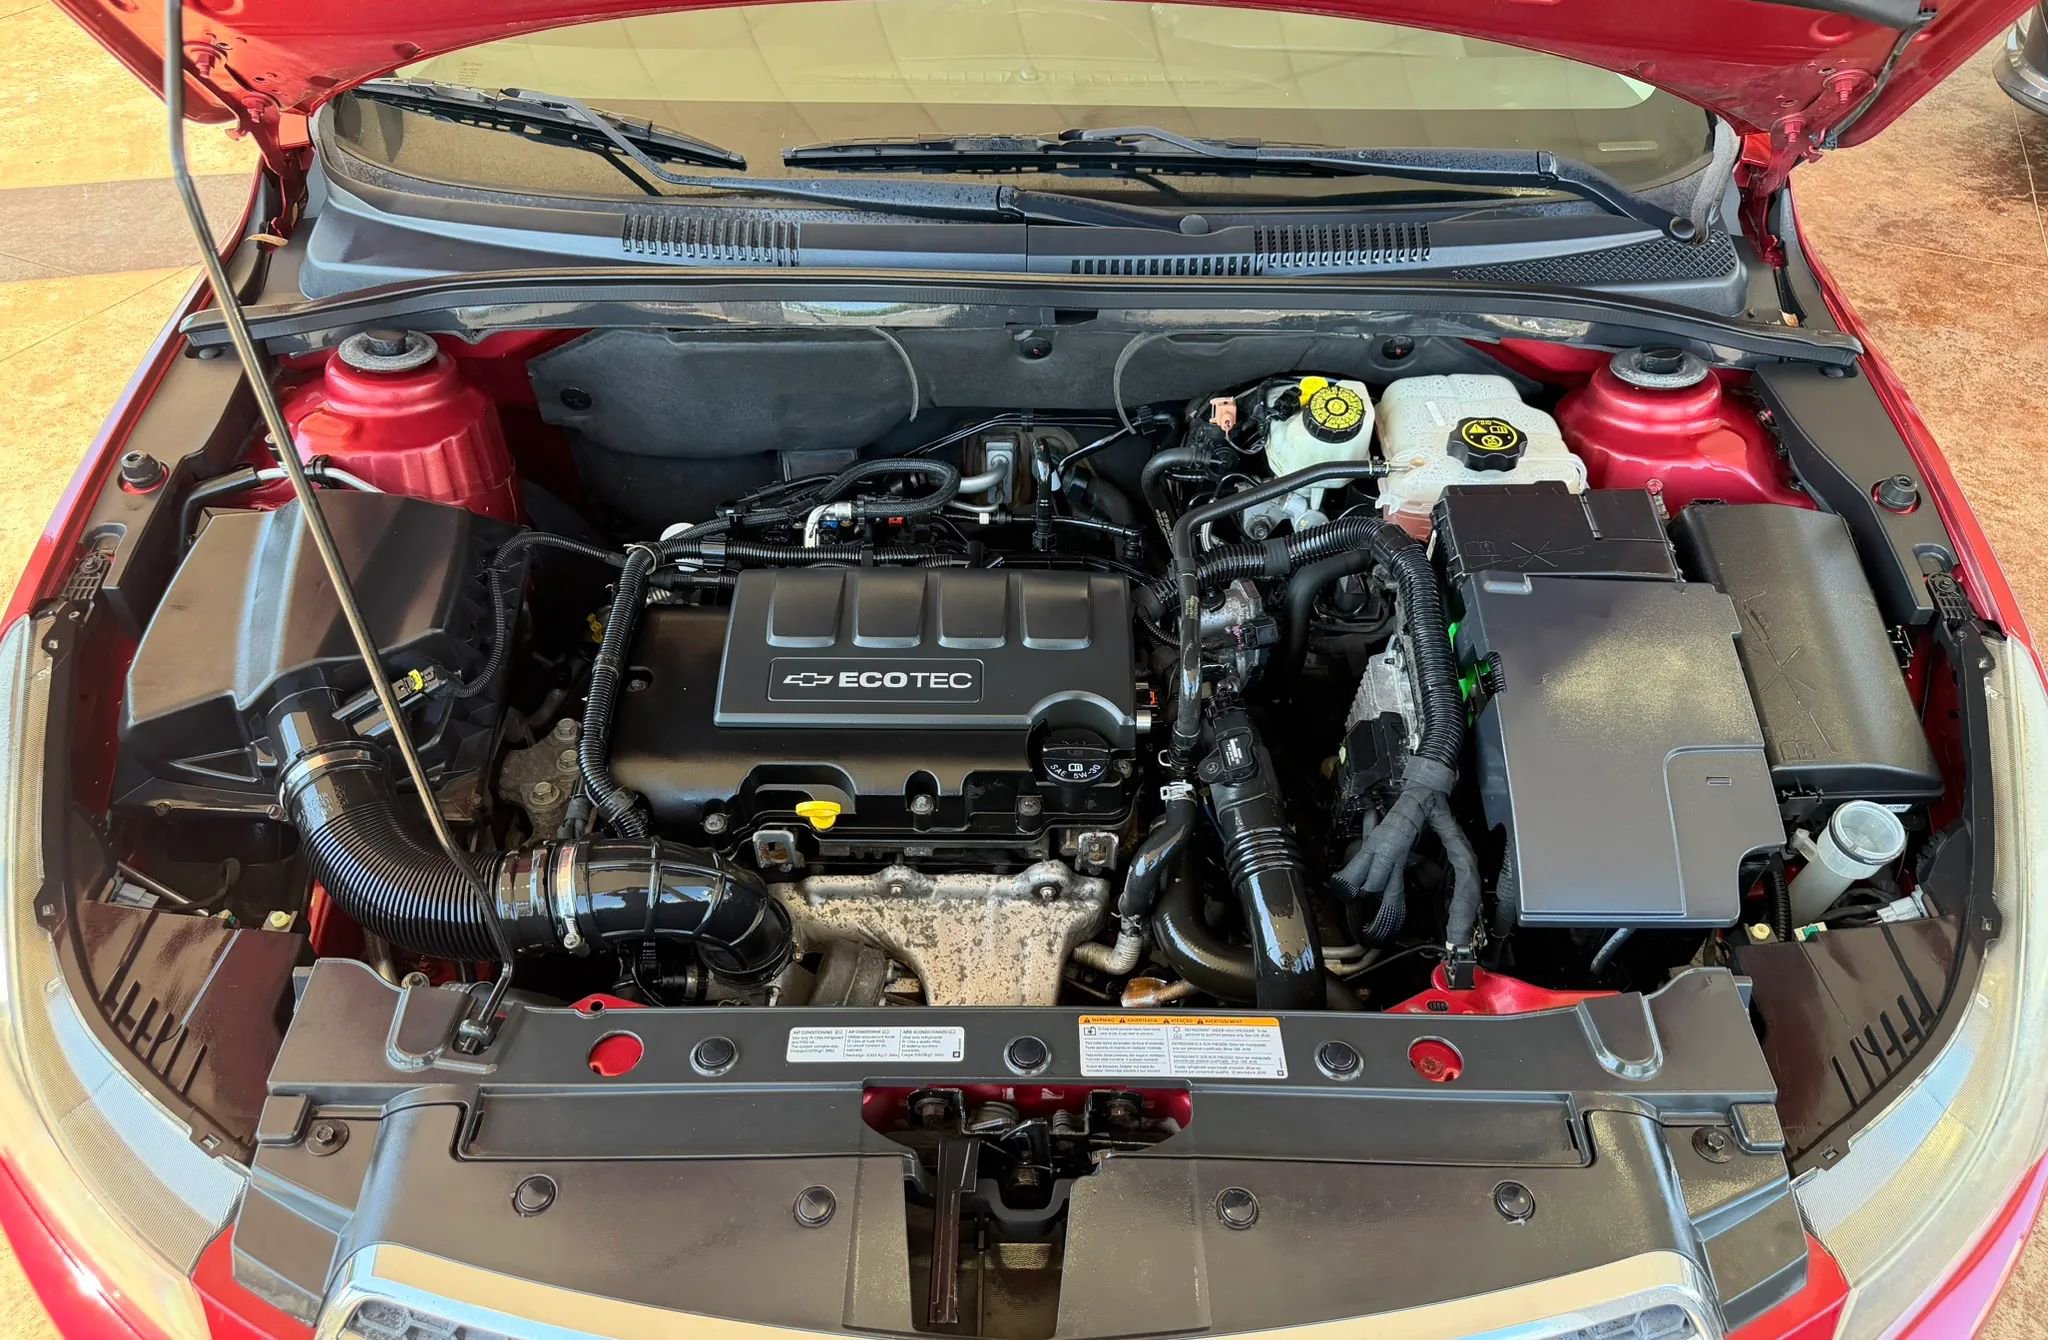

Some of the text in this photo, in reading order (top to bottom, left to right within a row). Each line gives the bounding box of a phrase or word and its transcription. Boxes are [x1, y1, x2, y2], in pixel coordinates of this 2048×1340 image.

[838, 671, 972, 689] ECOTEC
[1050, 764, 1101, 779] SAE 5W-30
